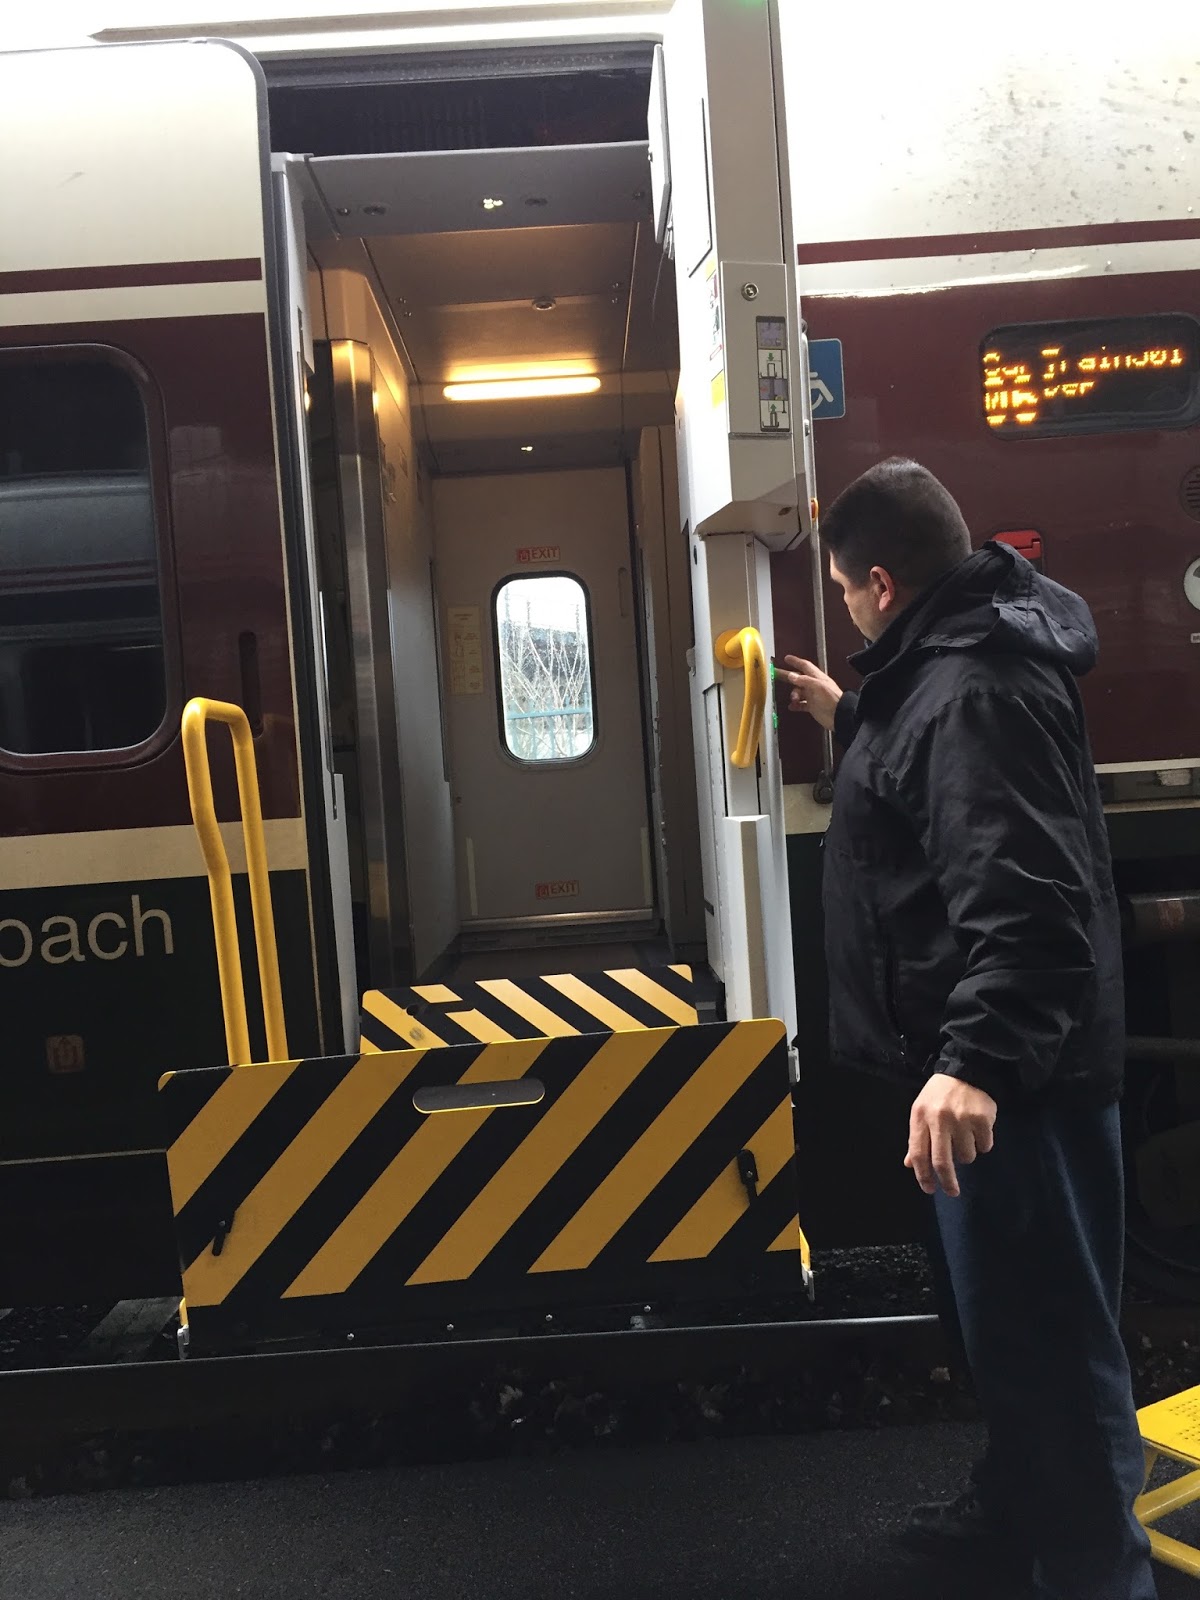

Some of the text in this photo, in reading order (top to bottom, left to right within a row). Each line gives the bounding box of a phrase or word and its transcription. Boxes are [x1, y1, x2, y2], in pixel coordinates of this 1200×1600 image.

[531, 547, 558, 559] EXIT
[550, 882, 576, 895] EXIT
[0, 894, 174, 968] oach
